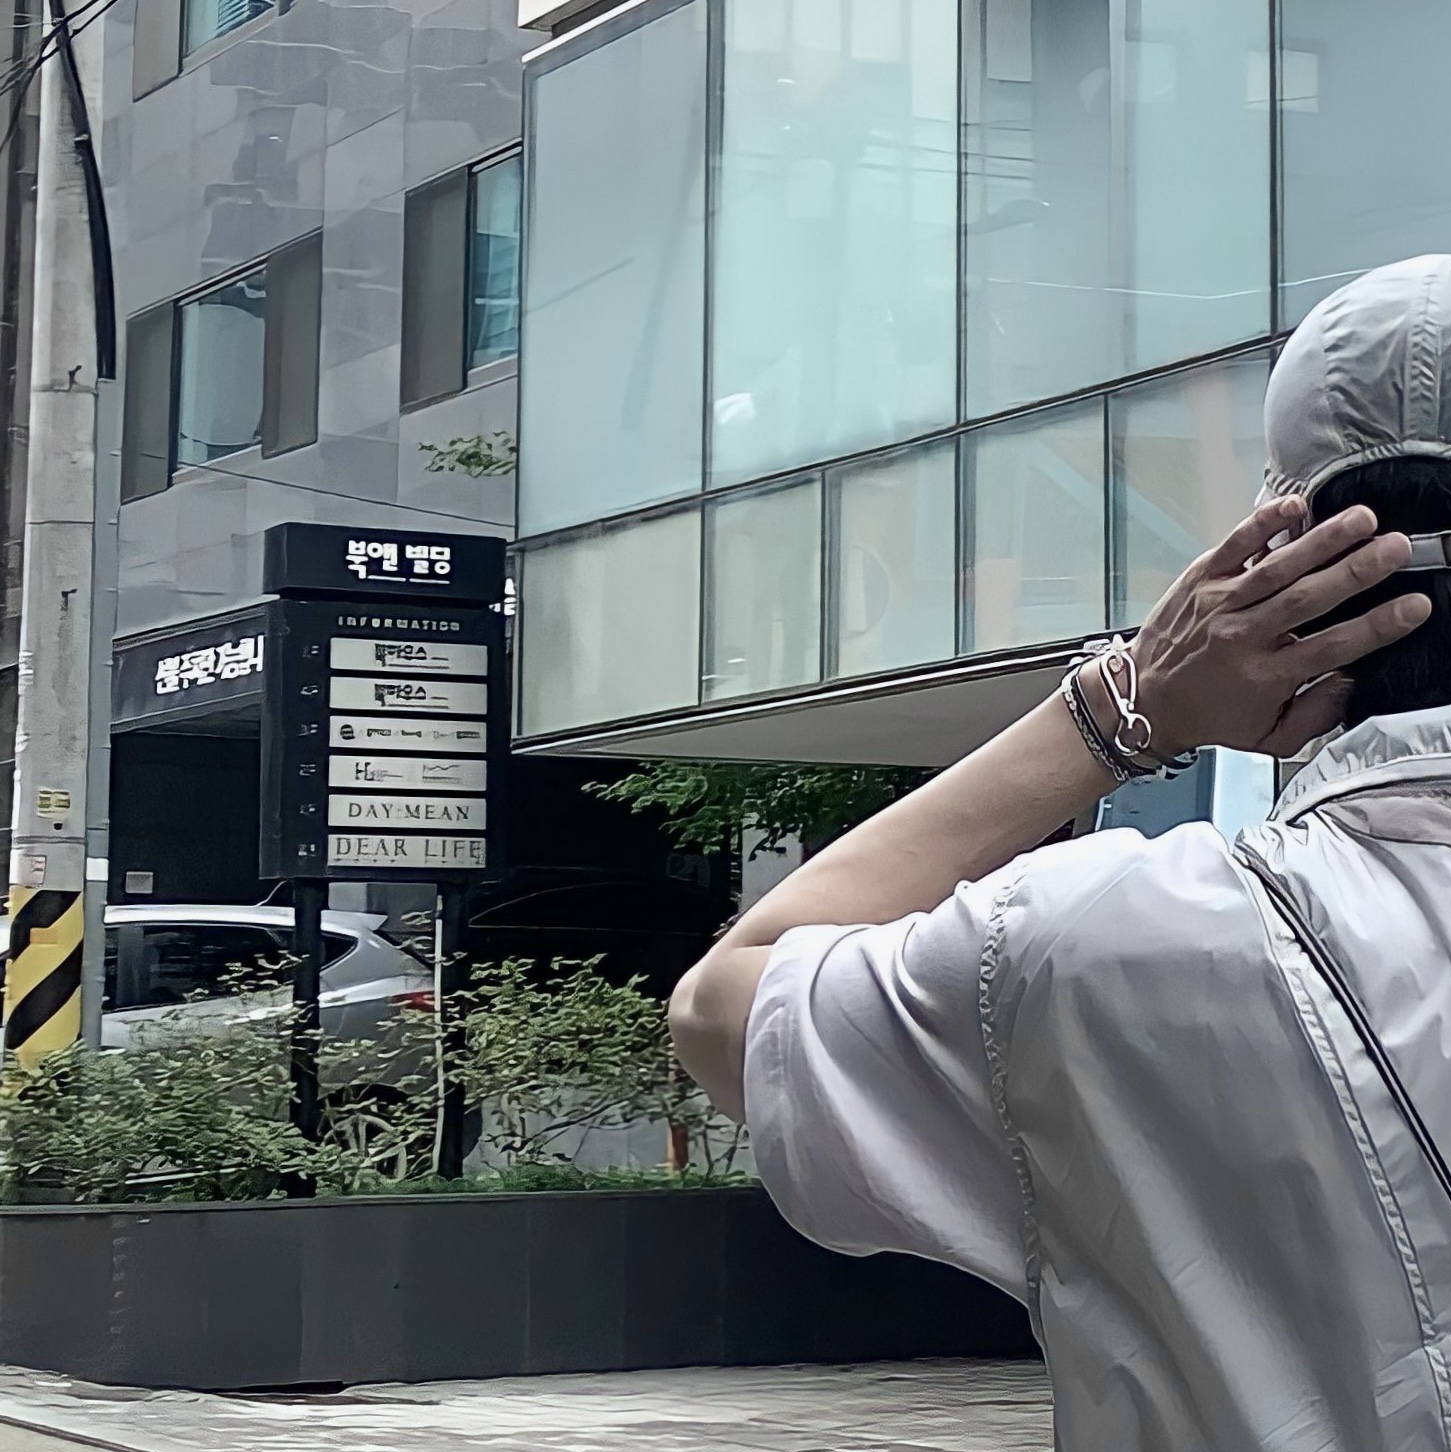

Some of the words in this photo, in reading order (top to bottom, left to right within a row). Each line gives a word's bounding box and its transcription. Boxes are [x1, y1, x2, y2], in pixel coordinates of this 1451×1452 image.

[346, 540, 399, 579] 북앤
[405, 544, 451, 575] 빌딩
[338, 615, 461, 632] INFORMATION
[336, 837, 408, 857] DEAR
[424, 838, 483, 859] LIFE
